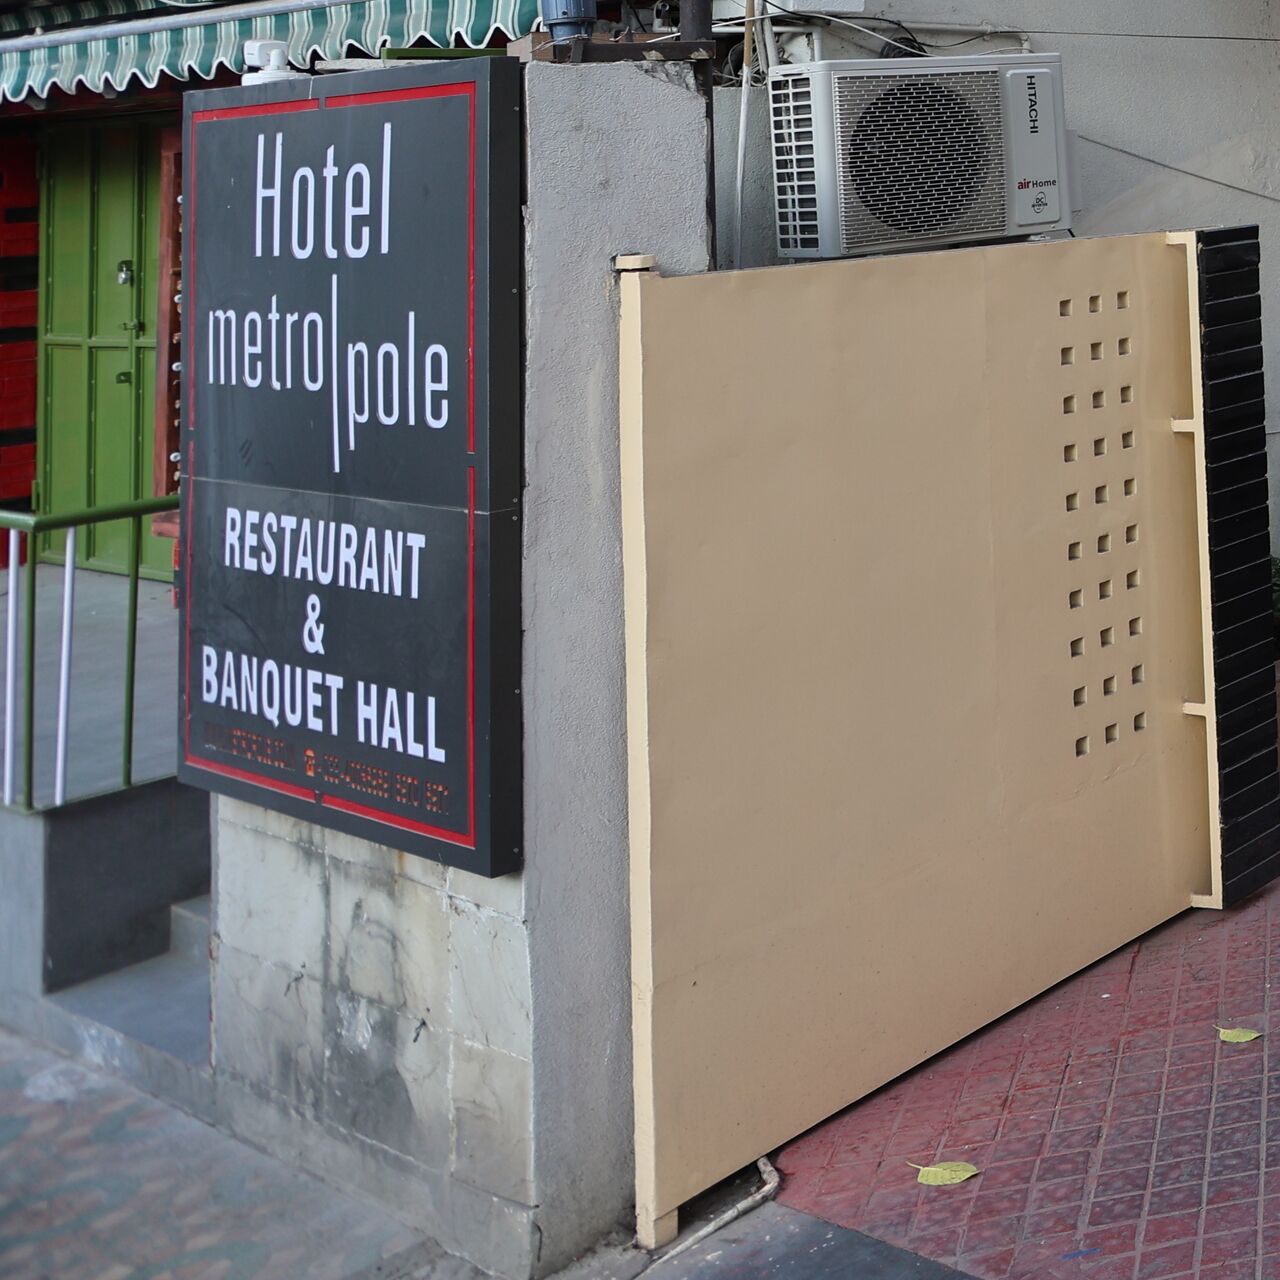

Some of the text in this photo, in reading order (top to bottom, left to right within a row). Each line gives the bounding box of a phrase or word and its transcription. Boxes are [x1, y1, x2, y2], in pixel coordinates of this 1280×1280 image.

[1026, 75, 1039, 134] HITACHI
[255, 122, 391, 260] Hotel
[224, 507, 426, 600] RESTAURANT
[302, 593, 325, 656] &
[202, 645, 344, 736] BANQUET
[357, 680, 447, 764] HALL
